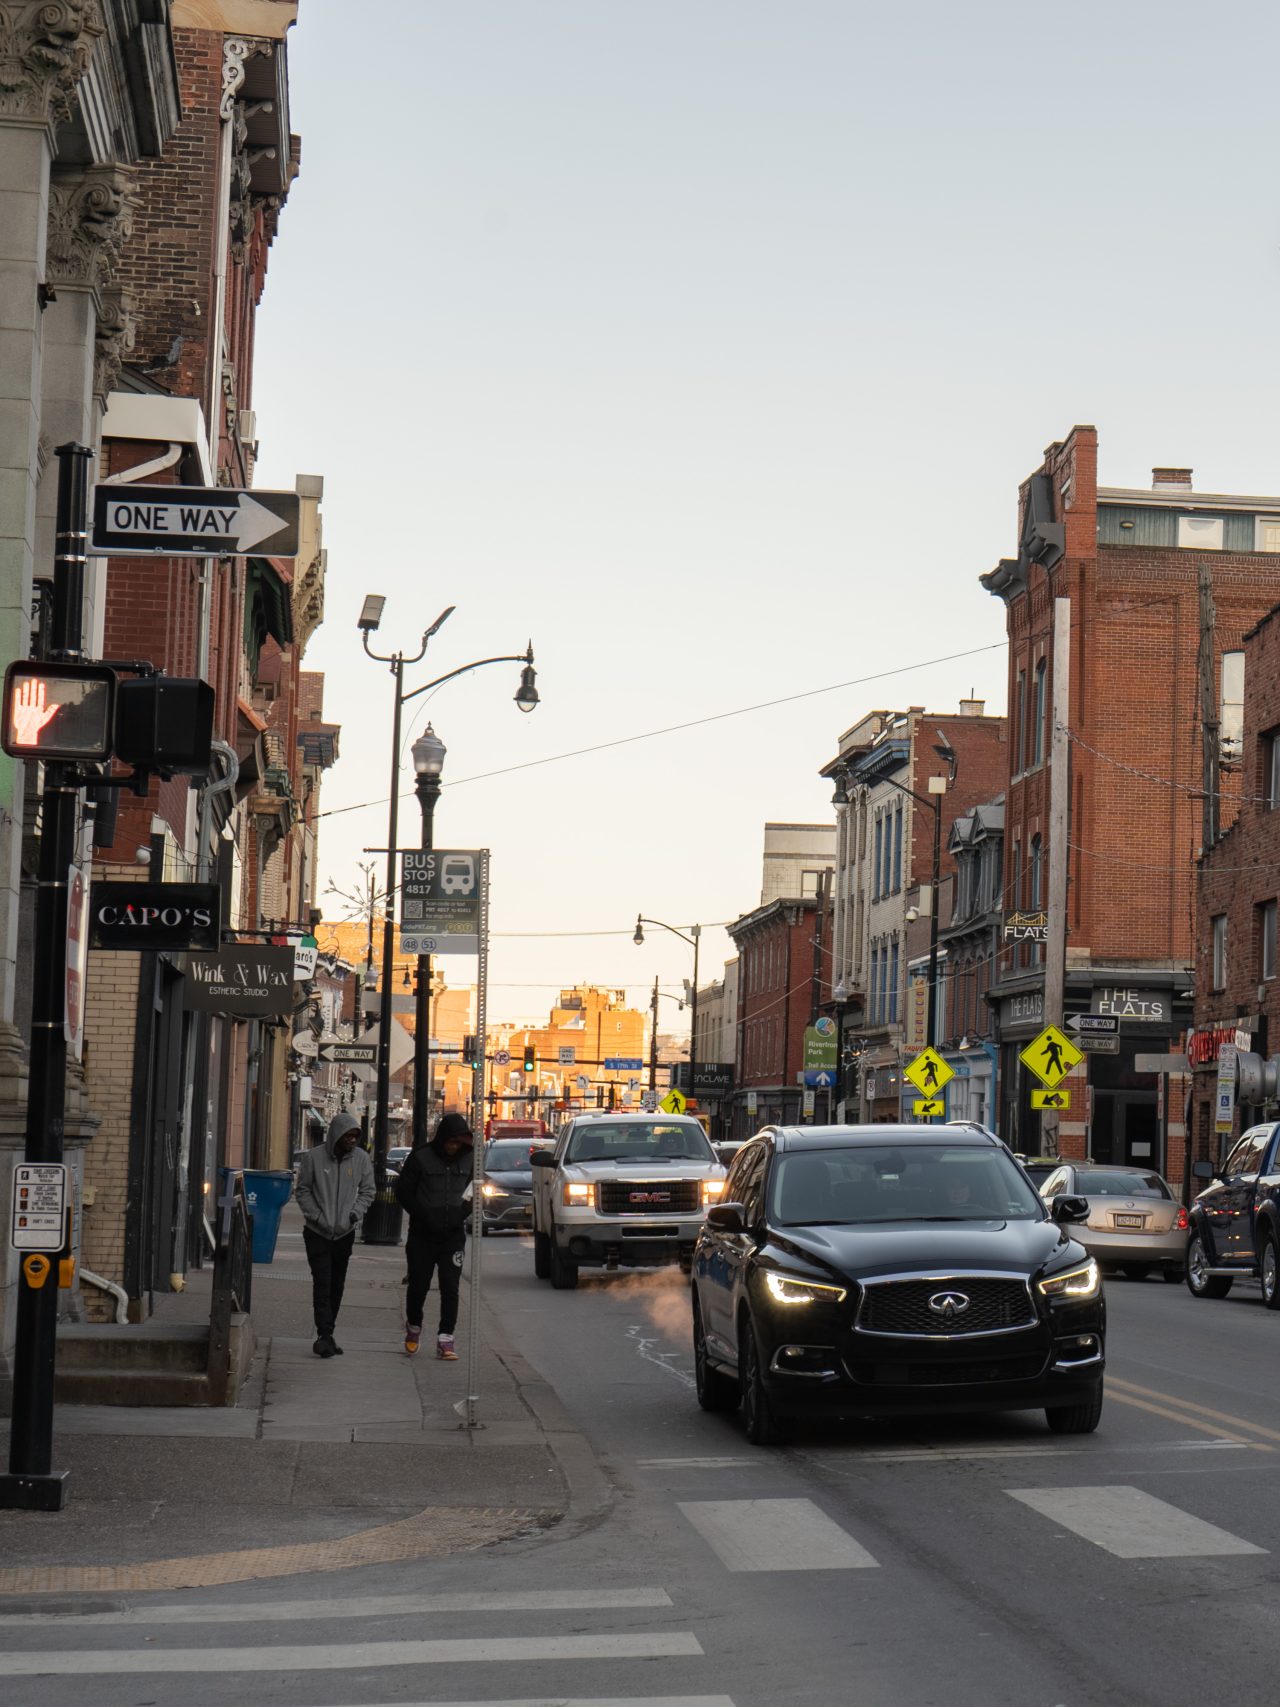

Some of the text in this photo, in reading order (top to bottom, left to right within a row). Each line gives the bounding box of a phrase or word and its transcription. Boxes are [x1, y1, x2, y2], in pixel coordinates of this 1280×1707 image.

[114, 505, 237, 534] ONE WAY
[404, 854, 436, 869] BUS
[404, 870, 436, 881] STOP
[406, 884, 432, 895] 4817
[98, 904, 212, 928] CAPO'S
[405, 940, 434, 949] 48 51
[191, 961, 289, 987] Wink & Wax
[209, 986, 269, 997] ESTHETIC STUDIO
[1101, 987, 1140, 1002] THE
[1010, 994, 1042, 1017] THE FLATS
[1099, 1001, 1163, 1016] FLATS
[1080, 1019, 1113, 1028] ONE WAY
[808, 1040, 838, 1049] Riverfron
[1097, 1040, 1113, 1048] WAY
[334, 1049, 371, 1058] ONE WAY
[808, 1048, 823, 1056] Park
[644, 1100, 656, 1108] 25
[629, 1192, 671, 1203] GMC
